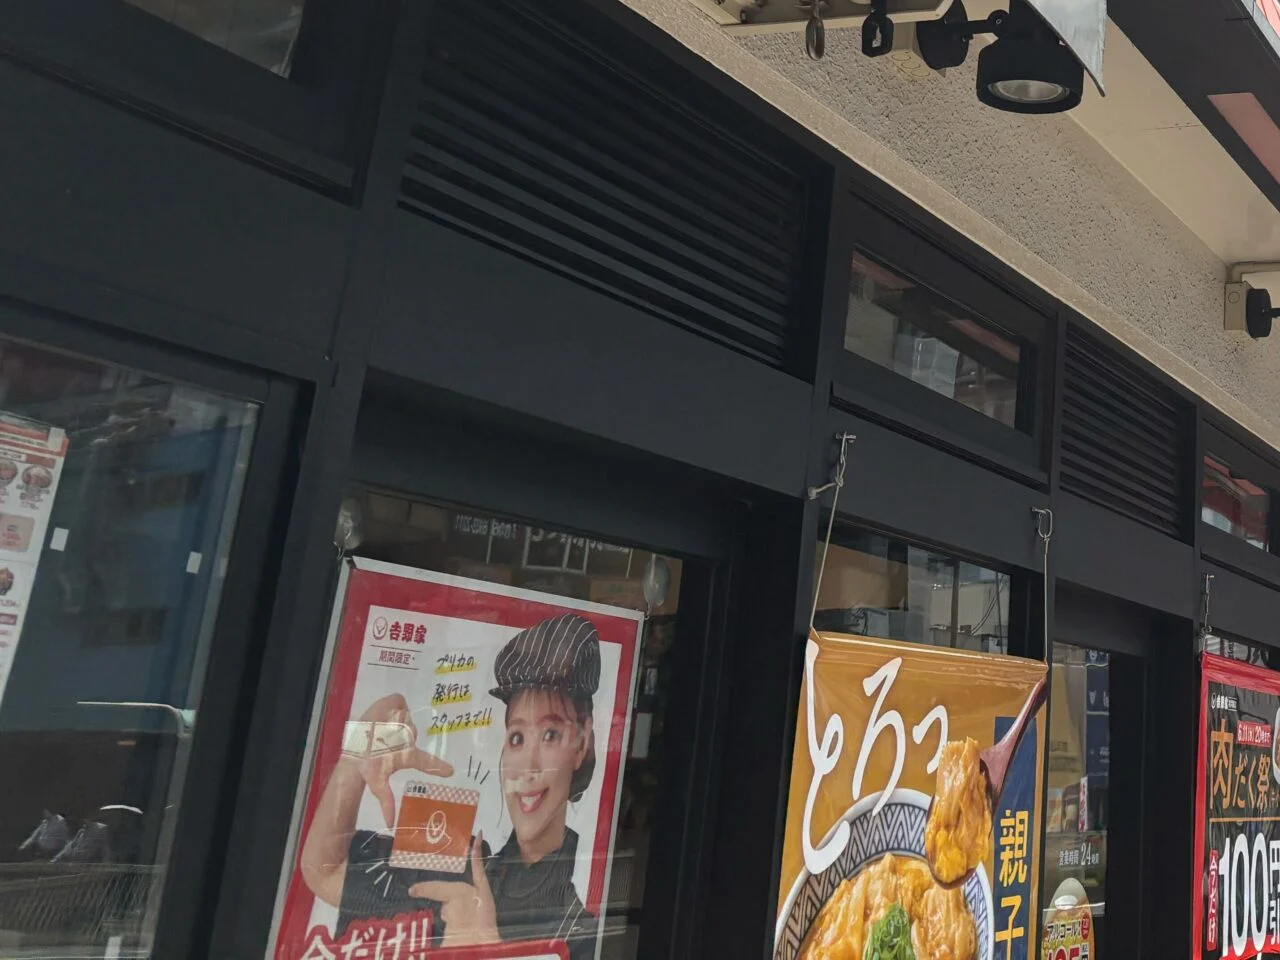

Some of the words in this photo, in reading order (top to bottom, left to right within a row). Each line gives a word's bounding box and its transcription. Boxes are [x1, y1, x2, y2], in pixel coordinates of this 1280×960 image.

[389, 622, 427, 644] 吉野家
[436, 653, 475, 671] プリカの
[432, 683, 470, 702] 発行は
[1209, 719, 1271, 814] 肉だく祭
[995, 809, 1028, 960] 親子
